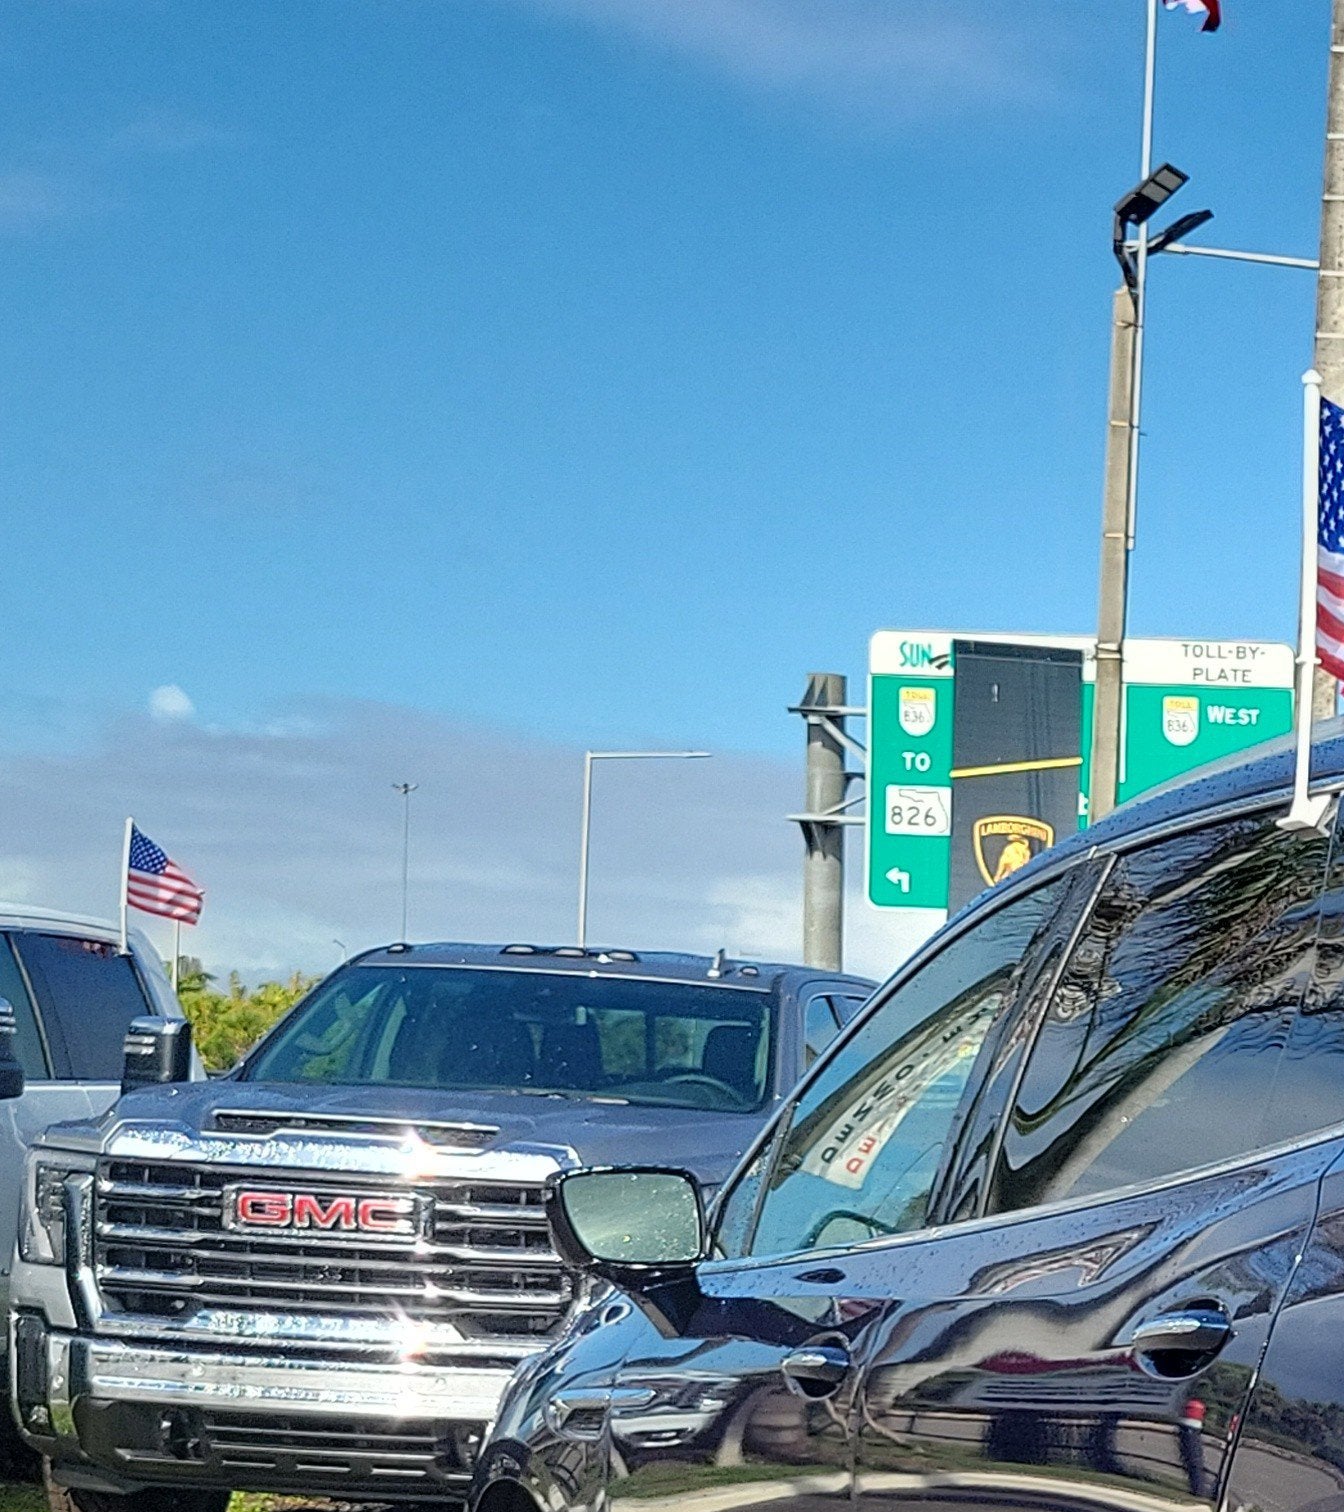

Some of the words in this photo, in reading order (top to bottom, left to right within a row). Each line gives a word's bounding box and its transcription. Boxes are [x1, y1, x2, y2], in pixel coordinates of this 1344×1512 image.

[1181, 643, 1266, 660] TOLL-BY-
[1192, 667, 1252, 683] PLATE
[1206, 704, 1260, 726] WEST
[901, 751, 931, 772] TO
[891, 805, 937, 827] 826
[238, 1191, 414, 1232] GMC
